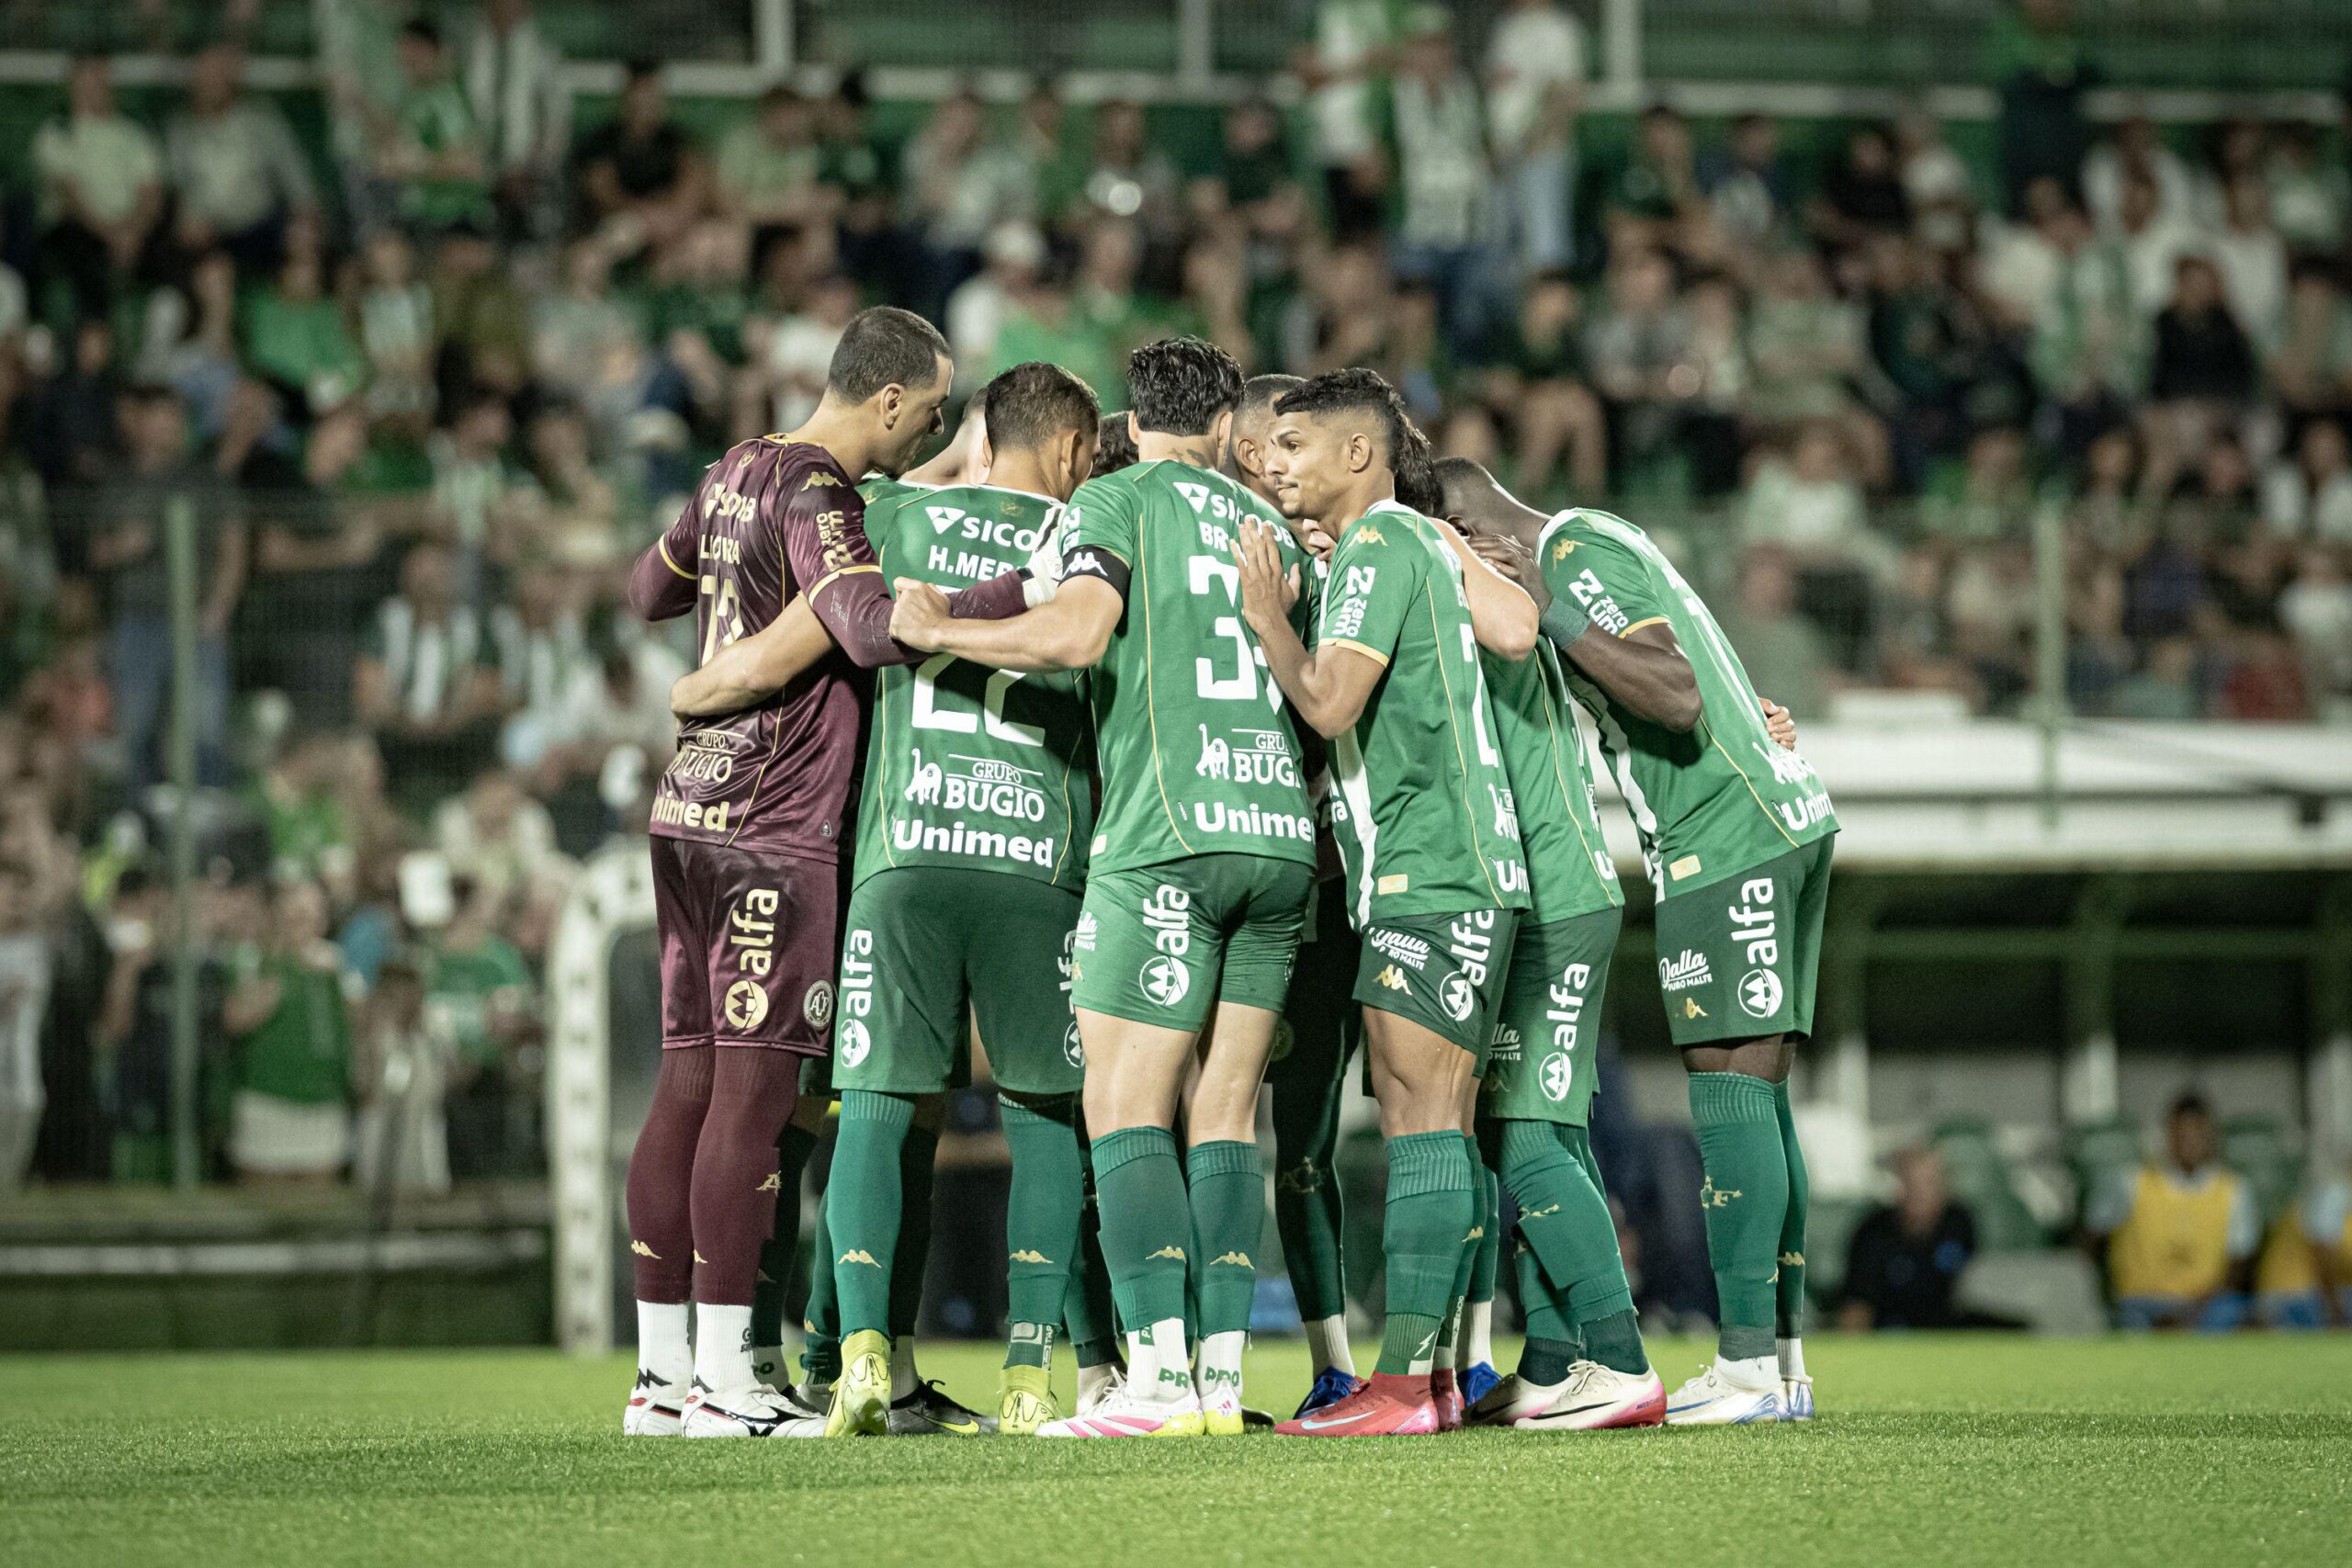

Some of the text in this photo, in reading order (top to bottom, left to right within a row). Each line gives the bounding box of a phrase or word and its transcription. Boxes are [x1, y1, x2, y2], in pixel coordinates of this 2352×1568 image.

[1345, 597, 1368, 637] zero
[1600, 595, 1628, 627] zero
[1255, 733, 1290, 752] GRU
[972, 761, 1022, 784] GRUPO
[650, 790, 730, 832] nimed
[944, 777, 1045, 822] BUGIO
[894, 819, 1054, 868] Unimed
[730, 888, 779, 976] alfa
[1143, 883, 1190, 956] alfa
[1728, 877, 1779, 965] alfa
[842, 929, 873, 1017] alfa
[1659, 949, 1707, 989] Dalla
[1686, 973, 1713, 987] MALTE
[1546, 963, 1590, 1050] alfa
